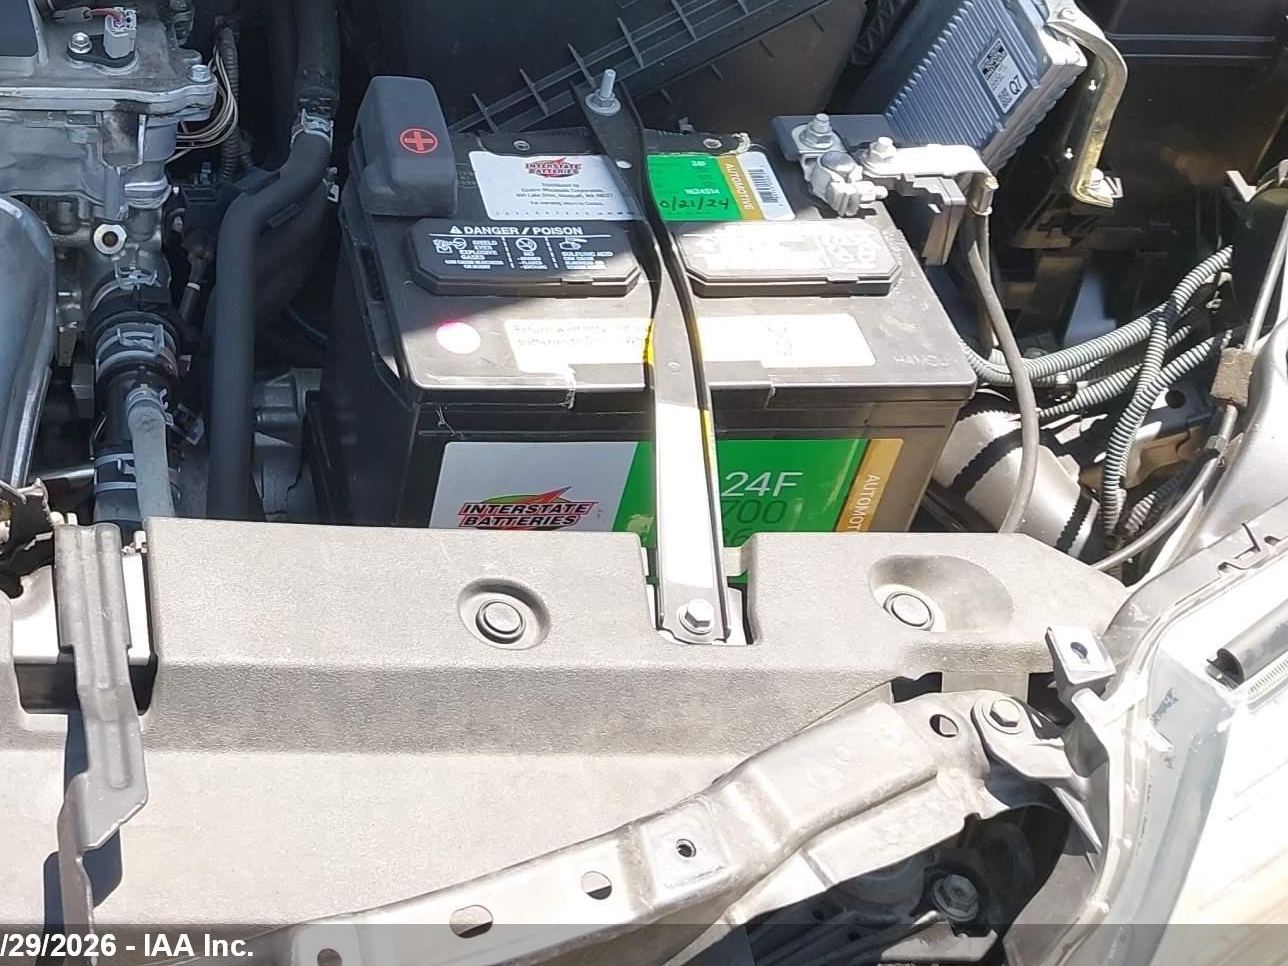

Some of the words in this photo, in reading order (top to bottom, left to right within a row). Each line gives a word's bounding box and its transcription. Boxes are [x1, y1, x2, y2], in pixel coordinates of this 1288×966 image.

[1009, 74, 1022, 96] Q7
[725, 163, 754, 210] AUTOMOTIVE
[463, 226, 519, 234] DANGER
[532, 227, 583, 235] POISON
[720, 471, 804, 497] 24F
[462, 503, 591, 514] INTERSTATE
[463, 515, 576, 526] BATTERIES
